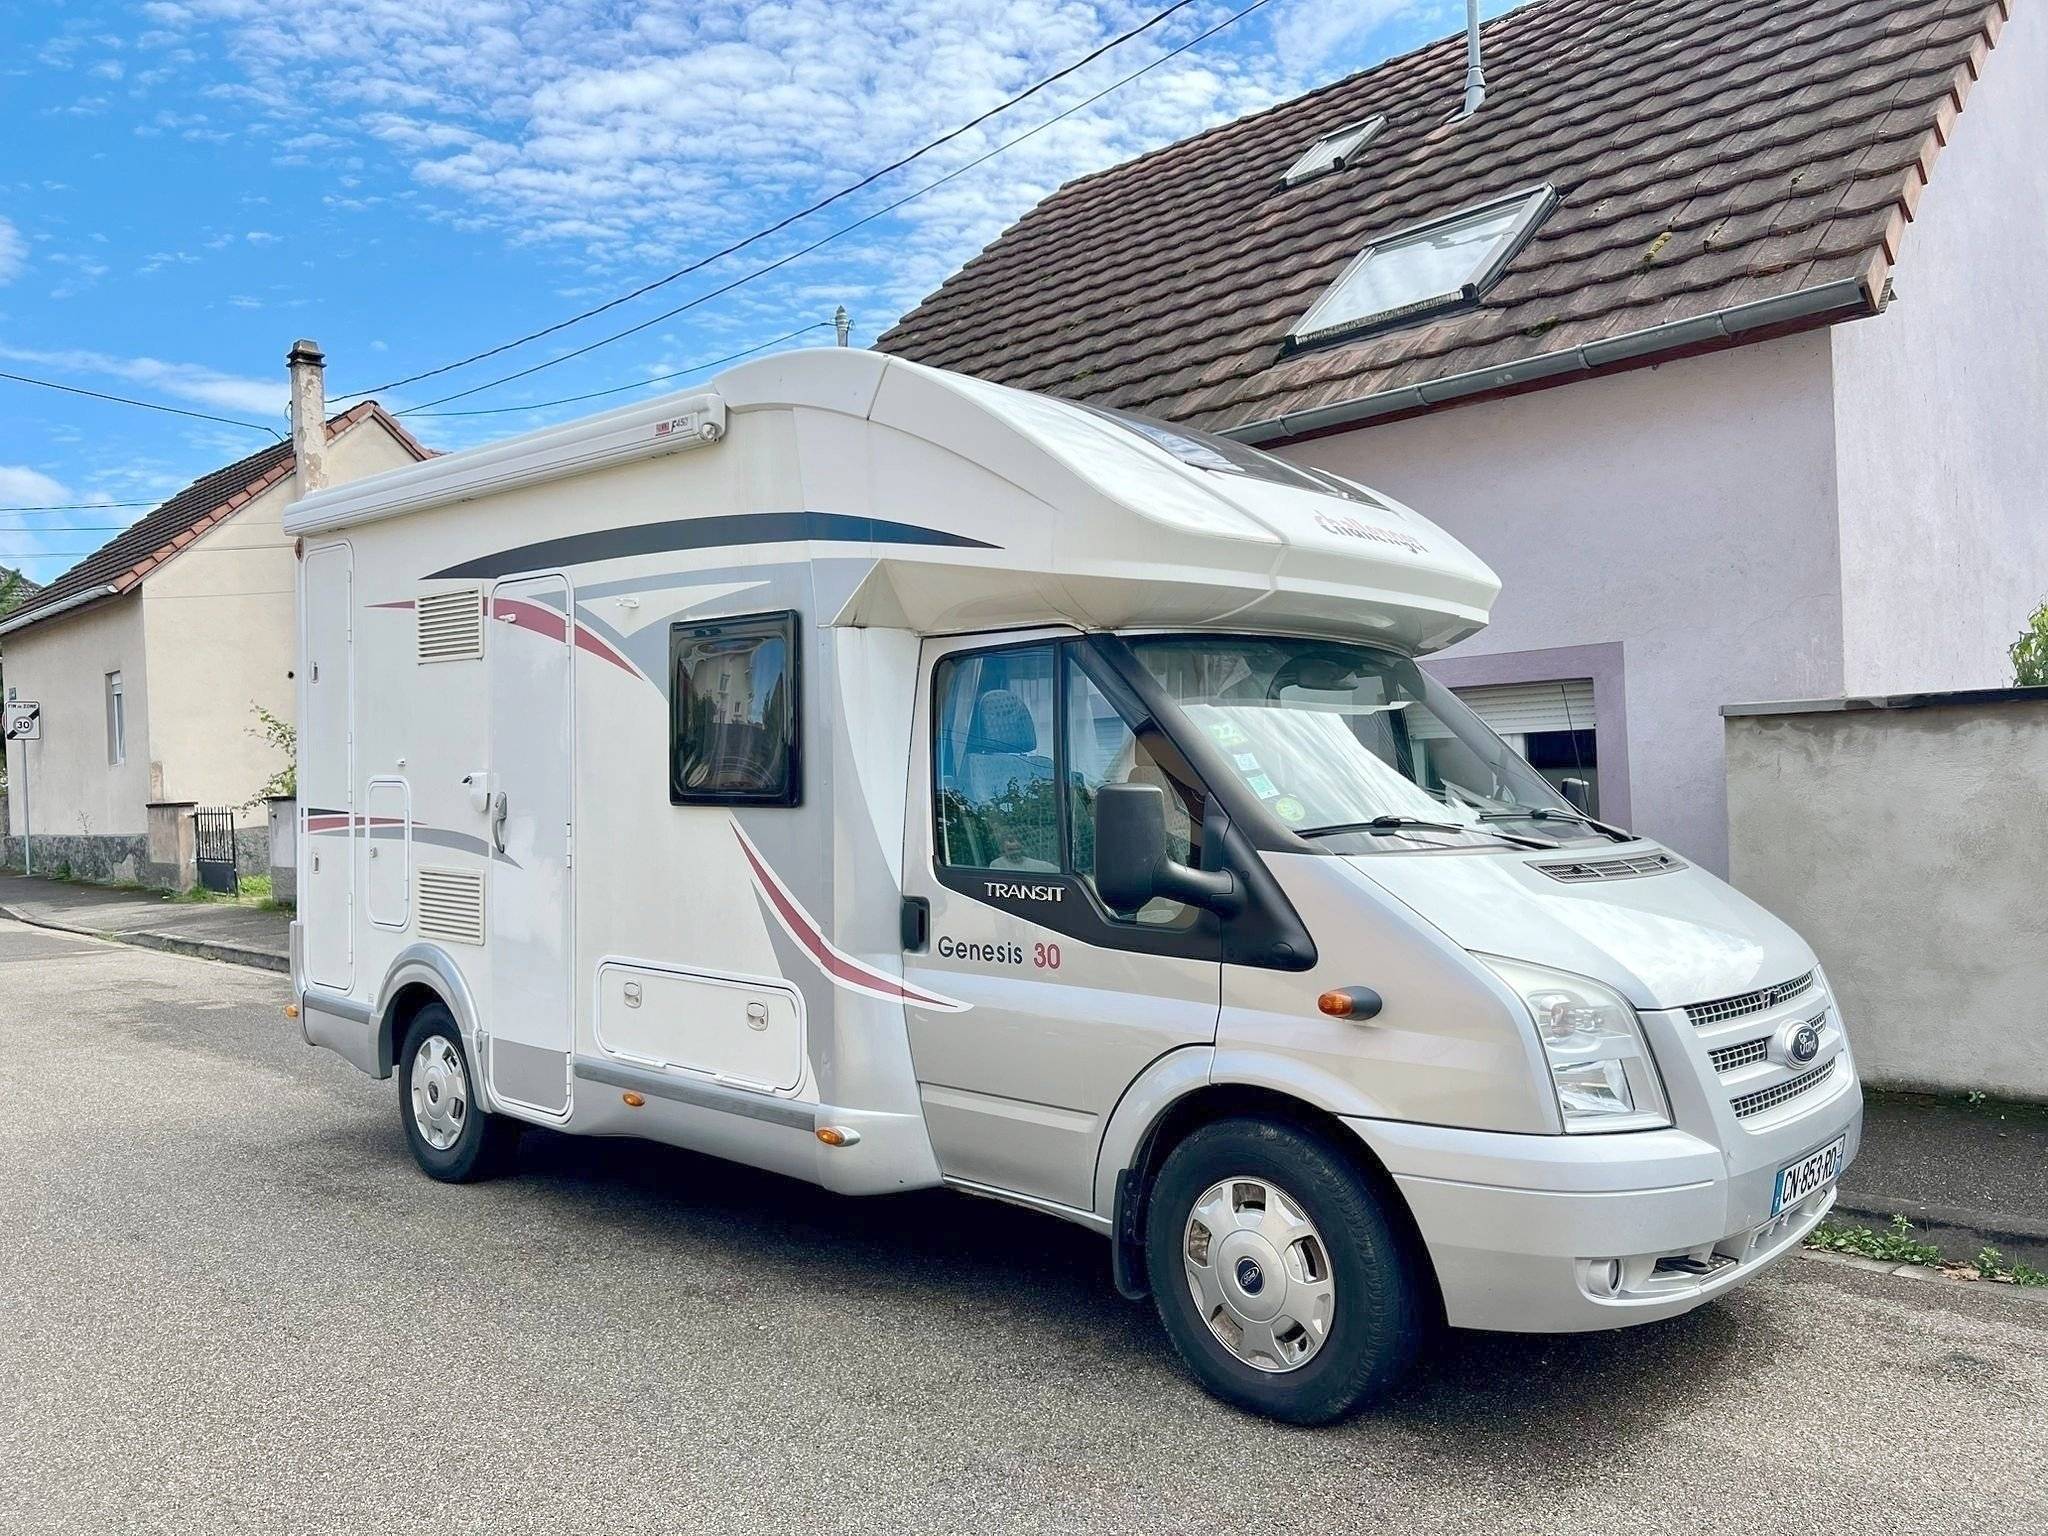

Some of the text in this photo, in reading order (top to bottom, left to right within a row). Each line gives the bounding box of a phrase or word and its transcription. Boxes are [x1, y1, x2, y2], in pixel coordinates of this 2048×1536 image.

[17, 721, 30, 729] 30
[984, 882, 1066, 902] TRANSIT
[938, 935, 1061, 969] Genesis 30
[1798, 1031, 1818, 1056] Ford
